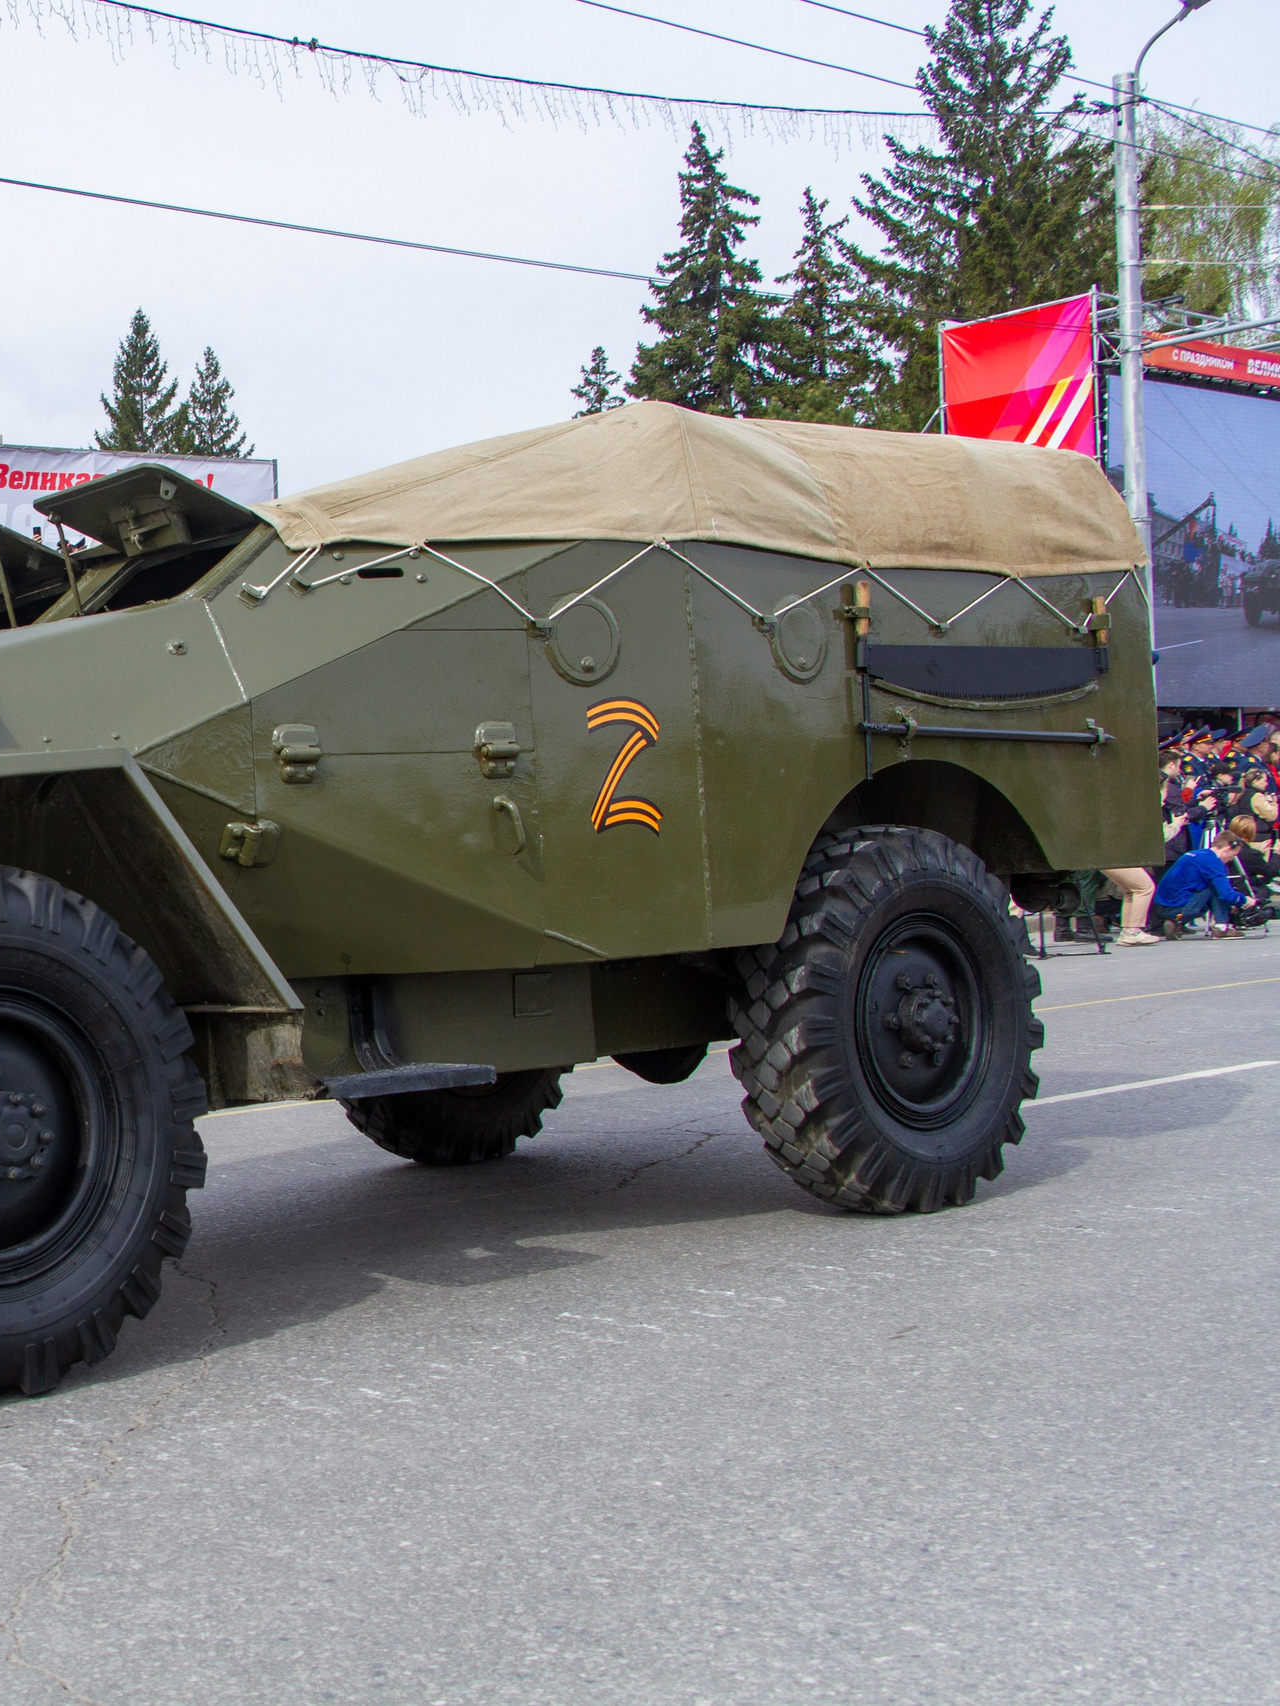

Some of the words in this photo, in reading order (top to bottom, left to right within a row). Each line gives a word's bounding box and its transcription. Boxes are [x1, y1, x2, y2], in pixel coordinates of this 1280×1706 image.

[1172, 349, 1179, 360] С
[1180, 350, 1234, 370] ПРАЗДНИКОМ
[587, 696, 663, 838] Z
